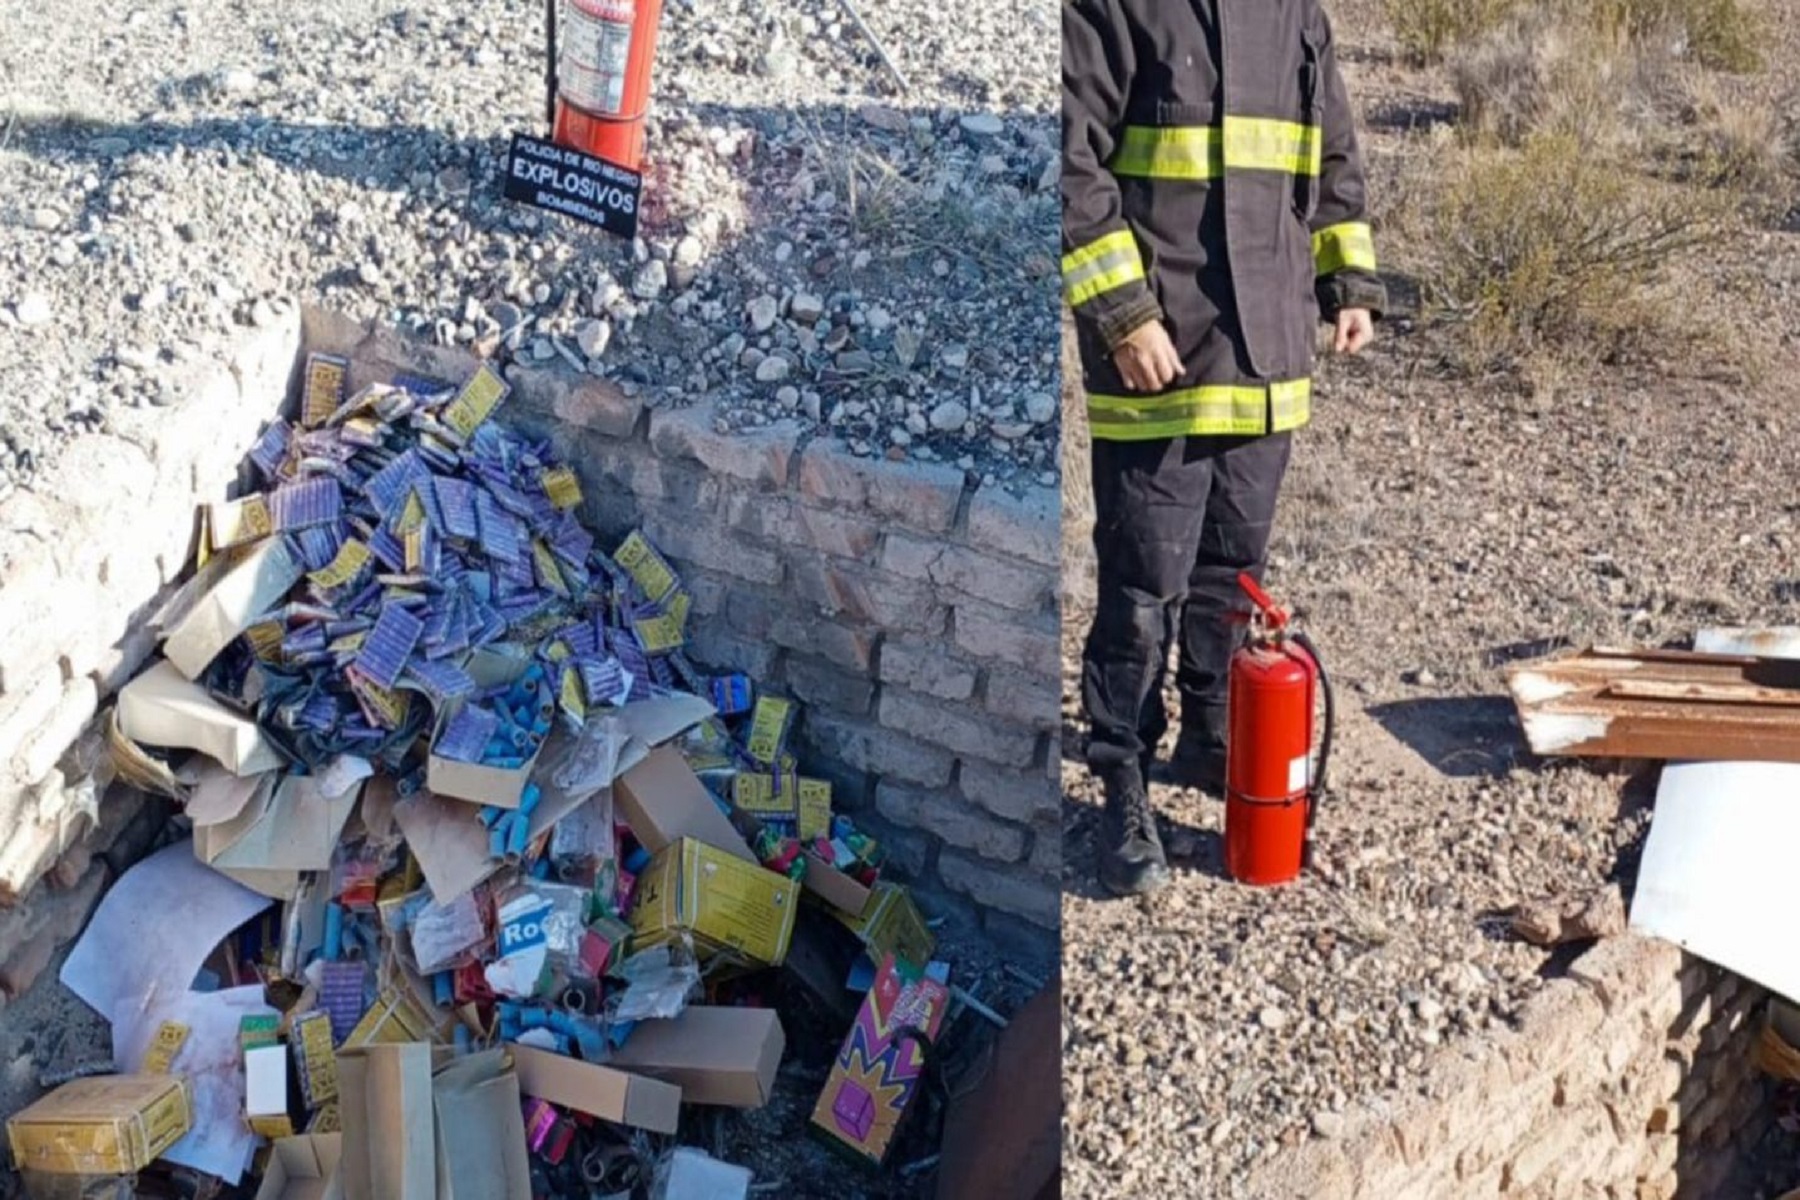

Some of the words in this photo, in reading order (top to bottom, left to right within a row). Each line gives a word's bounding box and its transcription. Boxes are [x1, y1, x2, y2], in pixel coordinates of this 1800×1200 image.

[512, 158, 635, 213] EXPLOSIVOS
[564, 151, 581, 166] DE
[582, 157, 602, 173] RIO
[602, 163, 639, 188] NEGRO
[536, 191, 605, 224] BOMBEROS
